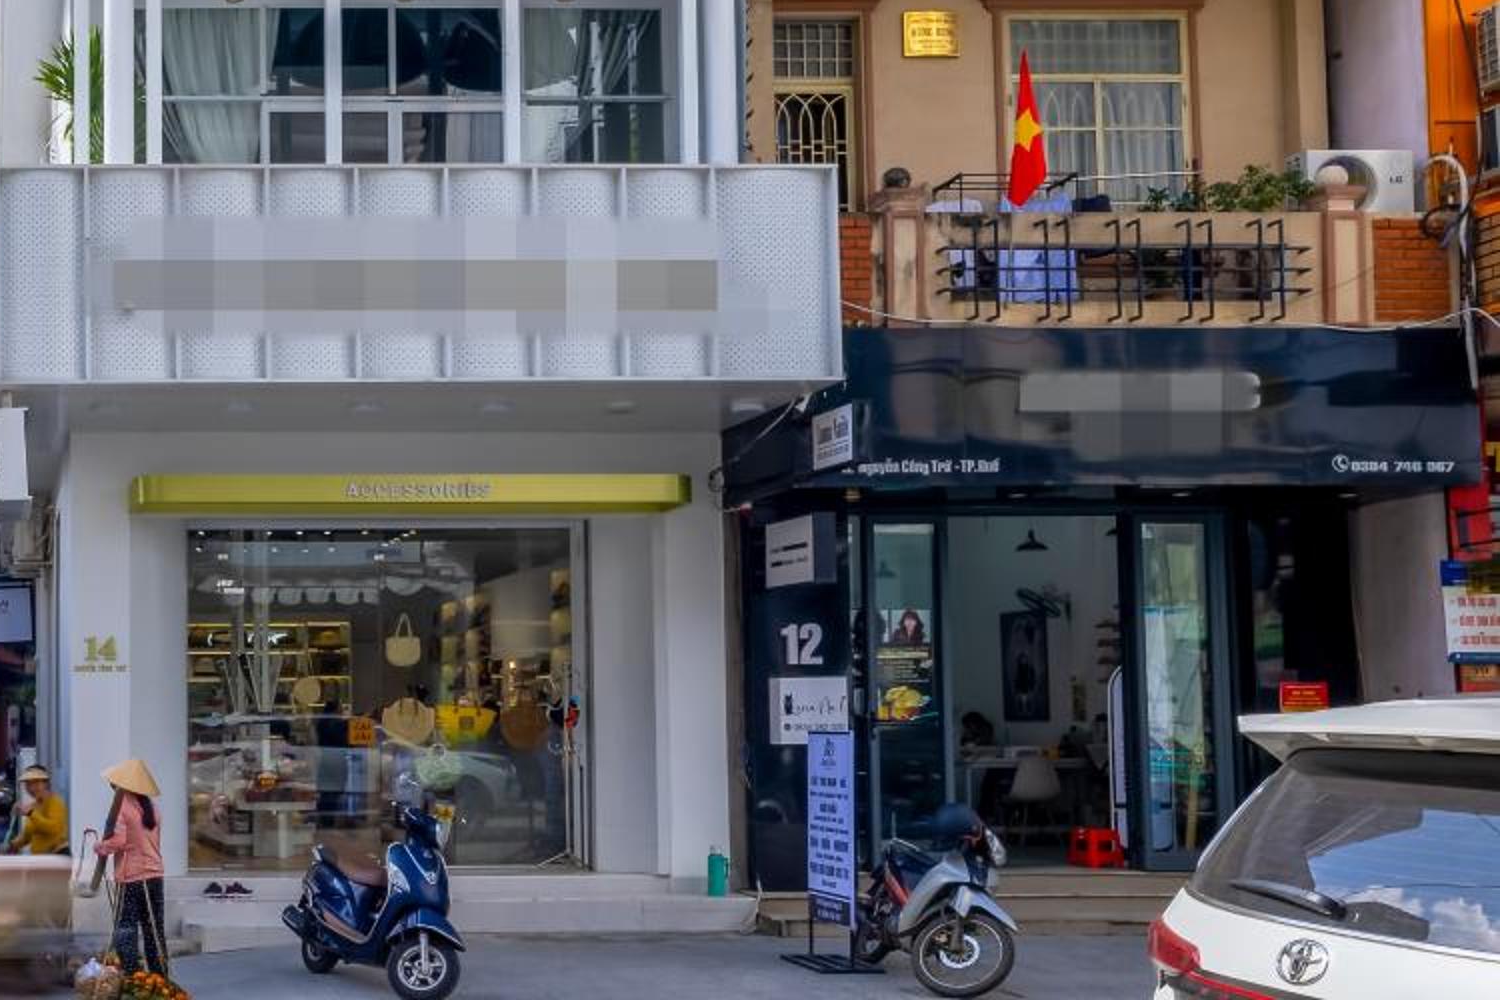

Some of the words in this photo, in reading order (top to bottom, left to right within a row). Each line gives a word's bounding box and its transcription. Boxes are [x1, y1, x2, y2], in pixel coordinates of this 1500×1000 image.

[345, 480, 491, 499] ACCESSORIES
[84, 635, 117, 662] 14
[780, 622, 824, 665] 12
